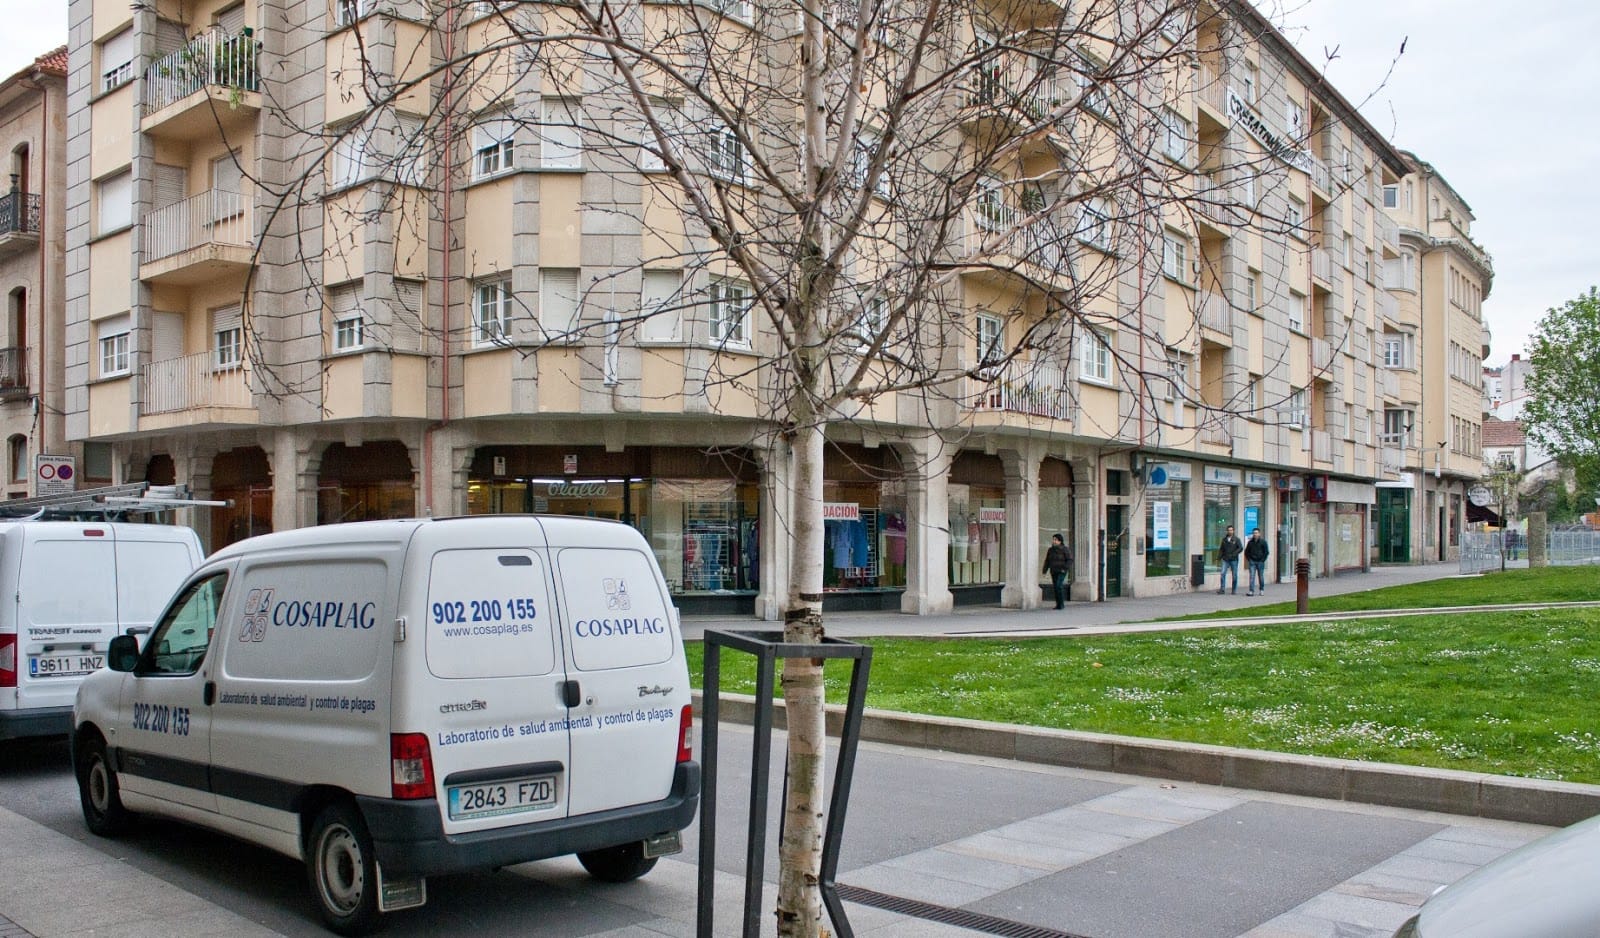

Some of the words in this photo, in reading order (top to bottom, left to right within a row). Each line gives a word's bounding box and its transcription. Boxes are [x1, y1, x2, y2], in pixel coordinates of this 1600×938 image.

[823, 505, 858, 518] DACIÓN
[273, 601, 376, 629] COSAPLAG
[433, 602, 466, 624] 902
[471, 600, 502, 621] 200
[507, 599, 536, 620] 155
[444, 623, 533, 637] www.cosaplag.es
[575, 617, 664, 638] COSAPLAG
[40, 658, 70, 672] 9611
[80, 656, 103, 670] HNZ
[219, 691, 249, 704] Laboratorio
[250, 694, 257, 704] de
[260, 693, 276, 706] salud
[278, 694, 307, 707] ambiental
[310, 699, 314, 711] y
[316, 696, 339, 710] control
[341, 696, 349, 710] de
[351, 696, 375, 713] plagas
[133, 702, 150, 730] 902
[152, 704, 170, 733] 200
[173, 706, 190, 736] 155
[438, 726, 499, 746] Laboratorio
[502, 724, 514, 738] de
[519, 720, 546, 735] salud
[549, 714, 592, 733] ambiental
[597, 718, 602, 729] y
[604, 712, 634, 725] control
[637, 710, 646, 721] de
[648, 708, 674, 722] plagas
[463, 787, 507, 810] 2843
[519, 781, 549, 803] FZD
